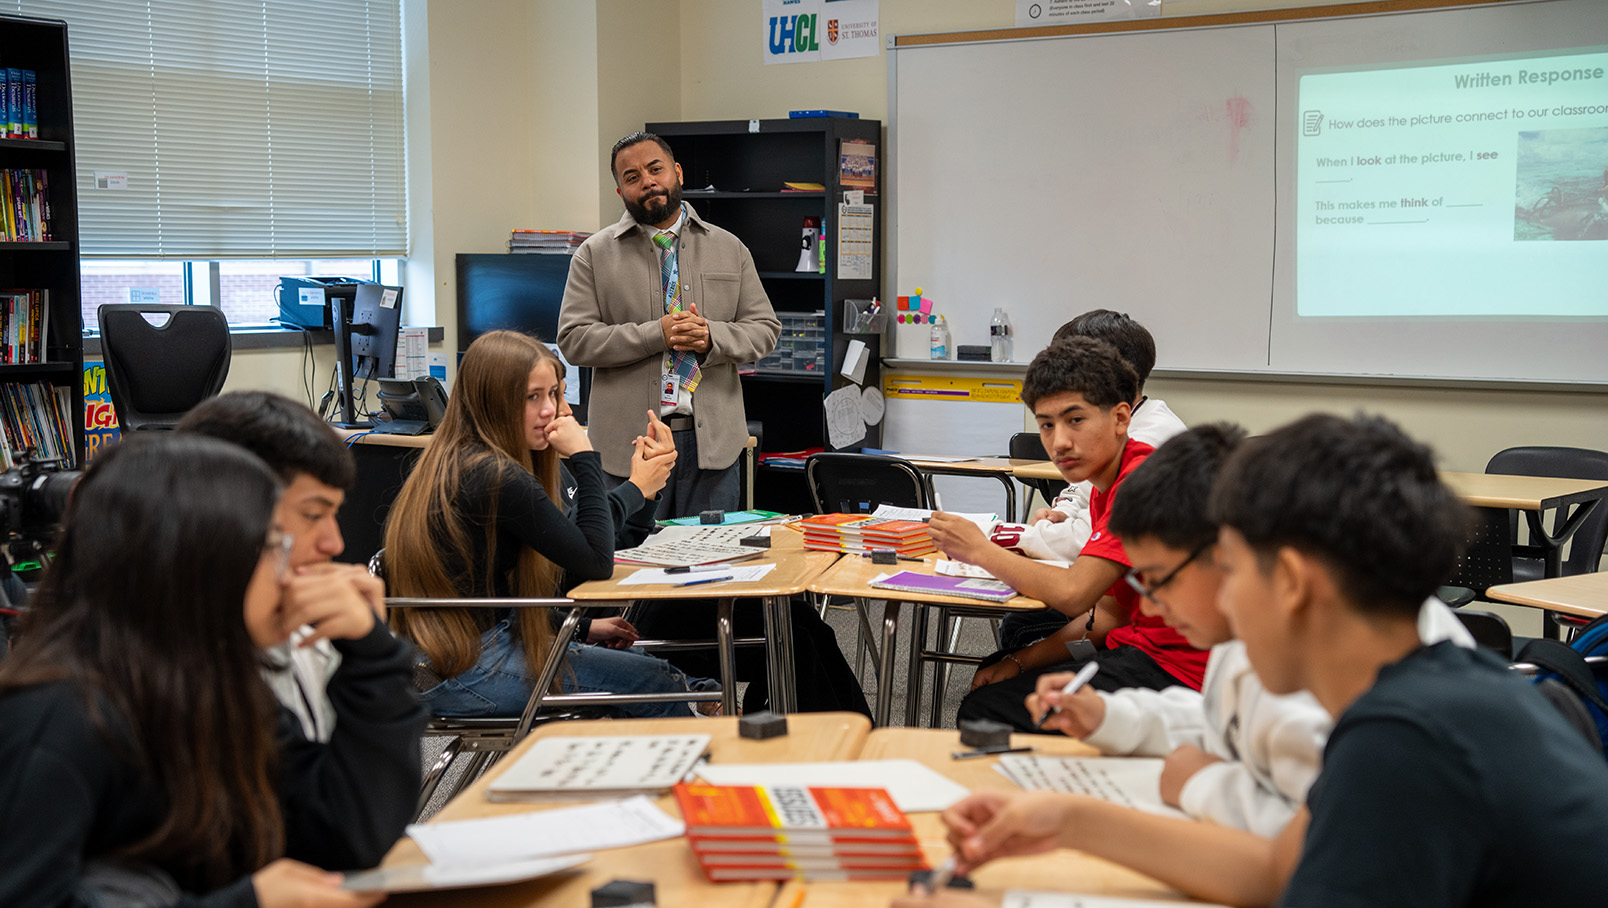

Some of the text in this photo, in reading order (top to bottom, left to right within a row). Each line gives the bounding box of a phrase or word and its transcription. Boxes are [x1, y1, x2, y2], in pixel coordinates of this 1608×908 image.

[769, 14, 819, 55] UHCL
[851, 29, 877, 39] THOMAS
[1454, 68, 1604, 89] Written Response
[1328, 105, 1608, 129] How does the picture connect to our classroo
[1316, 157, 1347, 167] When
[1350, 156, 1354, 166] I
[1357, 155, 1382, 166] look
[1385, 154, 1396, 164] at
[1399, 154, 1418, 164] the
[1421, 152, 1465, 165] picture,
[1476, 151, 1498, 160] see
[1315, 200, 1335, 211] This
[1338, 200, 1375, 210] makes
[1400, 197, 1428, 208] think
[1431, 196, 1443, 207] of
[1315, 215, 1364, 224] because
